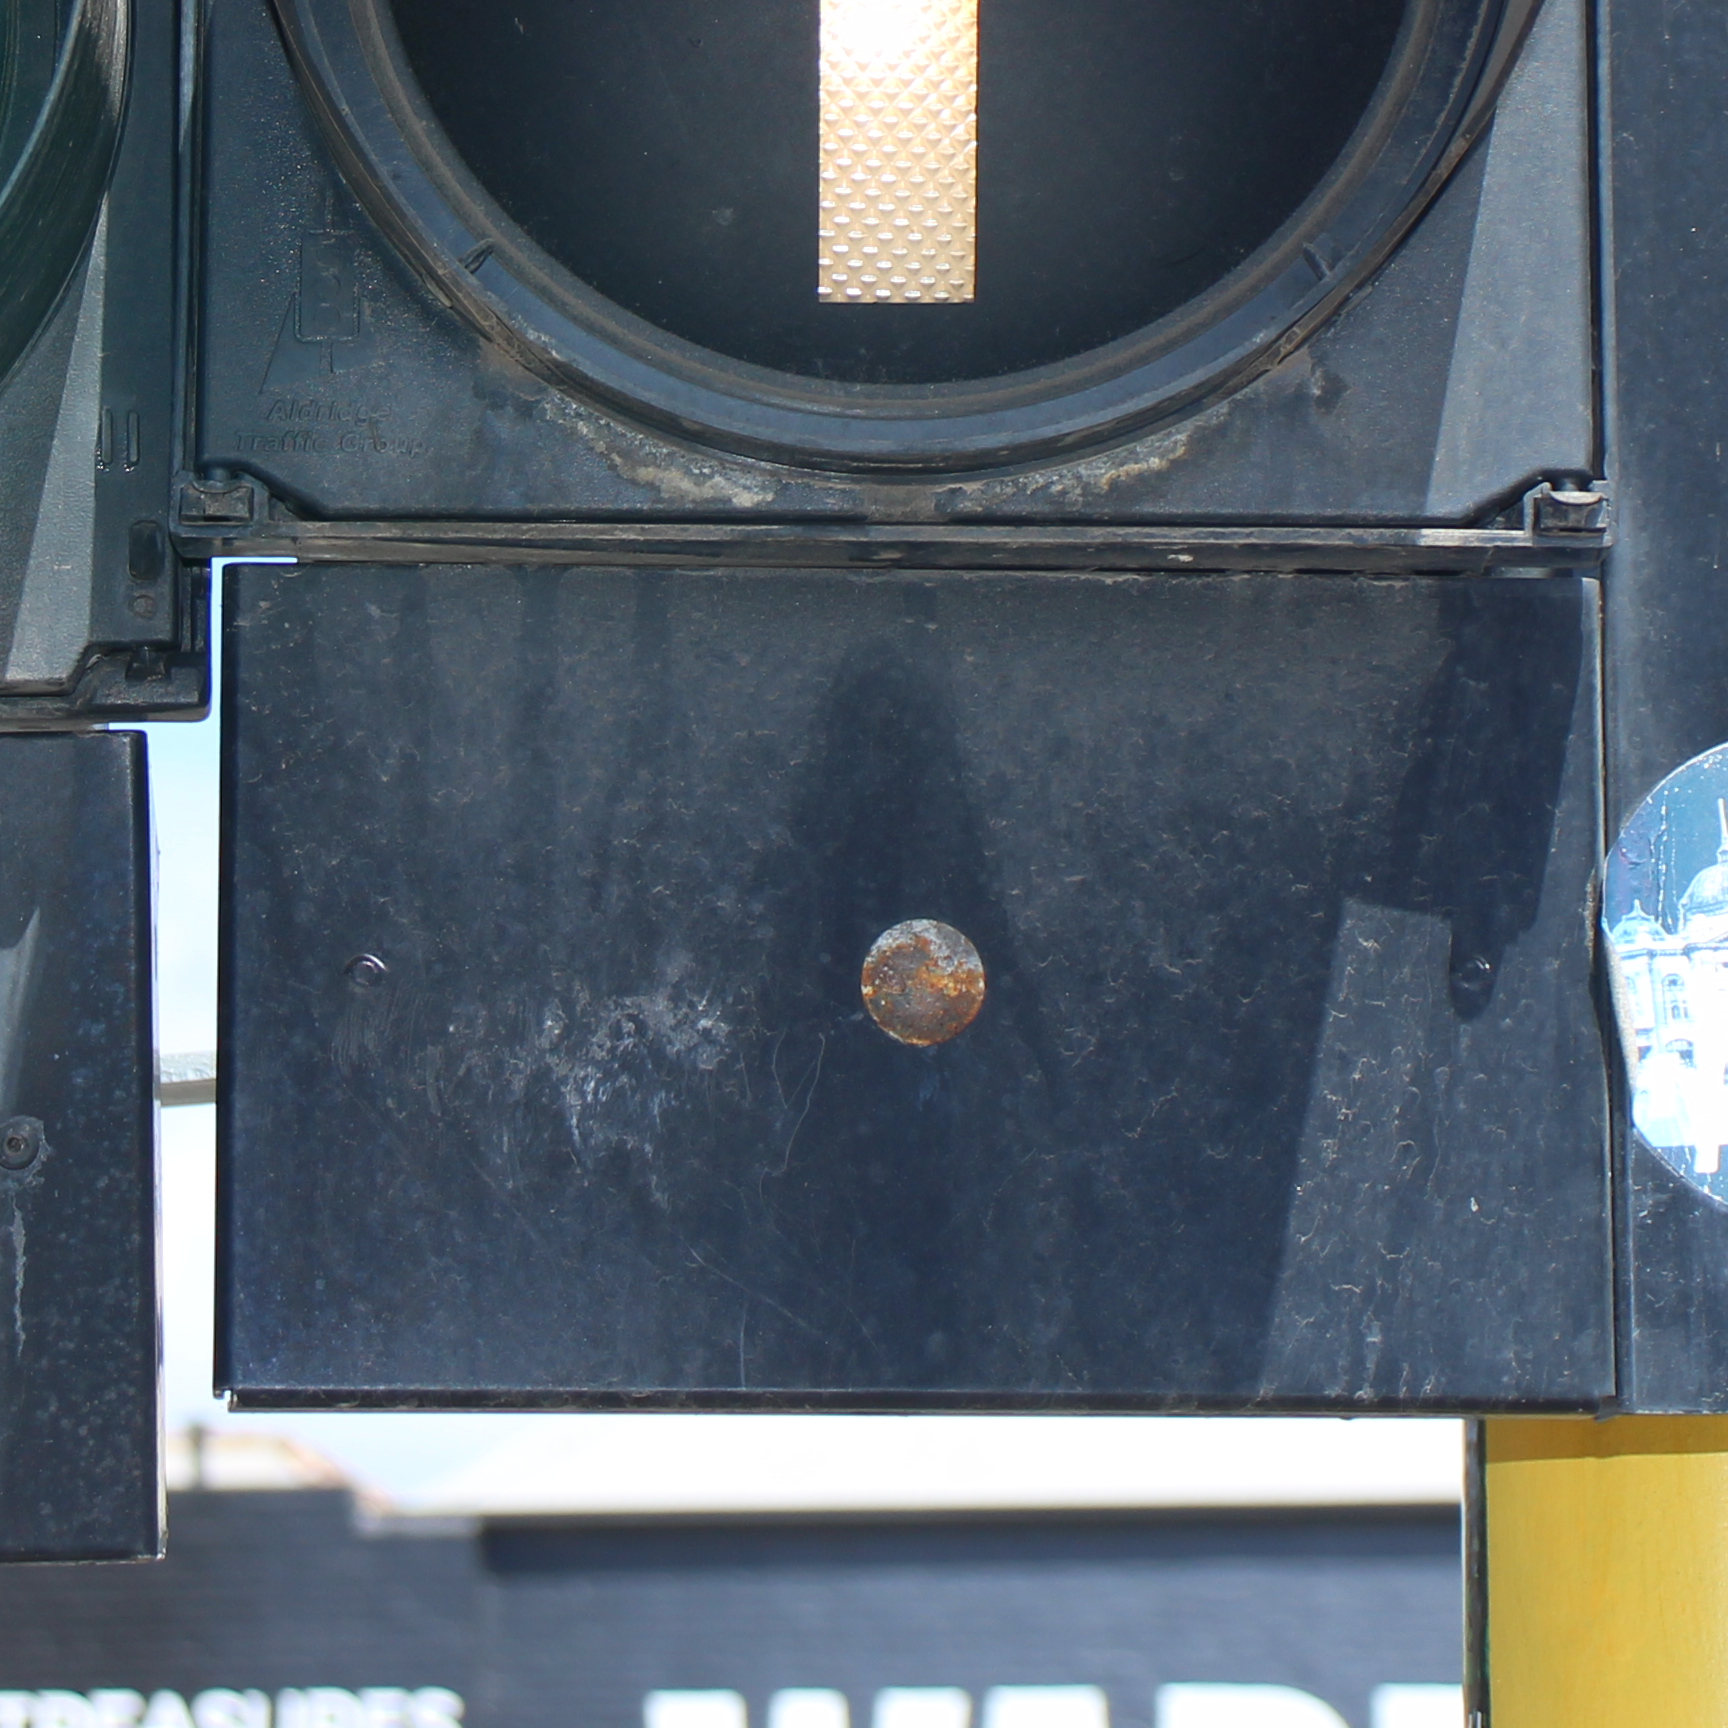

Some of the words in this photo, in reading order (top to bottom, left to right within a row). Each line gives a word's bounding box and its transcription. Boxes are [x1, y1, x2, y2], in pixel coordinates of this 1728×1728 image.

[266, 398, 392, 427] Aldridge
[234, 429, 327, 453] Traffic
[339, 429, 428, 459] Group
